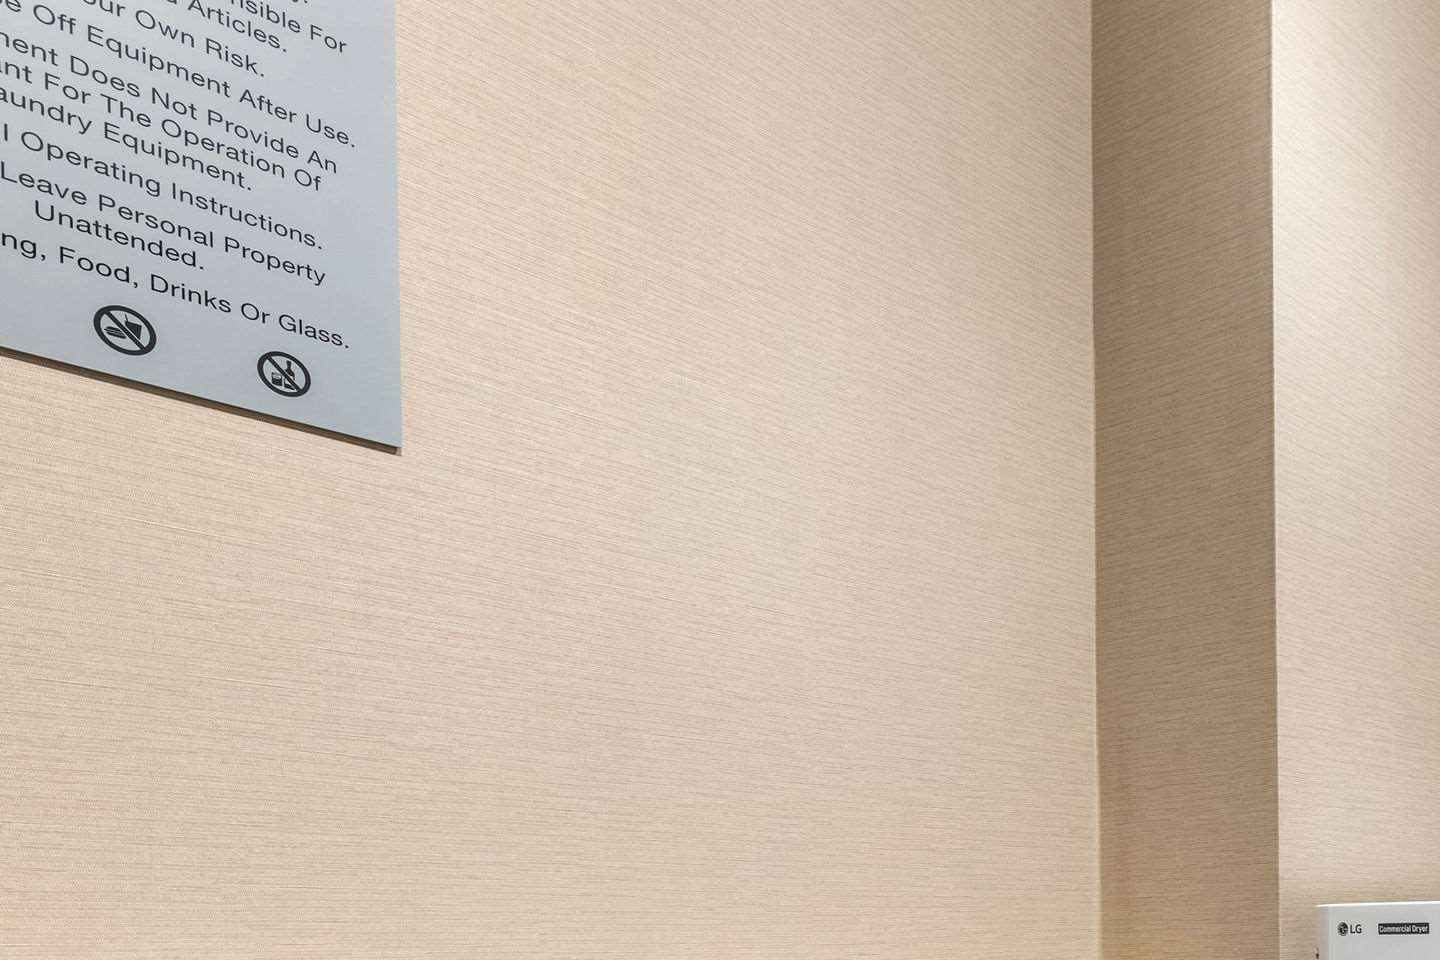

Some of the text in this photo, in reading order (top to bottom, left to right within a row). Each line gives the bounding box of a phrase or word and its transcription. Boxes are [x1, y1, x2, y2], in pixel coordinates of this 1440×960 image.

[135, 10, 195, 48] Own
[206, 37, 265, 77] Risk.
[188, 0, 287, 52] Articles.
[310, 24, 347, 53] For
[33, 4, 77, 35] Off
[87, 24, 231, 98] Equipment
[240, 89, 297, 123] After
[306, 113, 356, 148] Use.
[70, 55, 140, 98] Does
[152, 87, 197, 121] Not
[207, 109, 299, 159] Provide
[307, 150, 337, 174] An
[0, 61, 321, 191] nt For The Operation Of
[104, 121, 252, 191] Equipment.
[1, 161, 326, 286] Leave Personal Property
[21, 131, 161, 198] Operating
[172, 182, 323, 250] Instructions.
[35, 200, 204, 270] Unattended.
[59, 246, 138, 289] Food,
[150, 273, 232, 313] Drinks
[240, 302, 270, 324] Or
[278, 314, 349, 349] Glass.
[1350, 924, 1362, 934] LG
